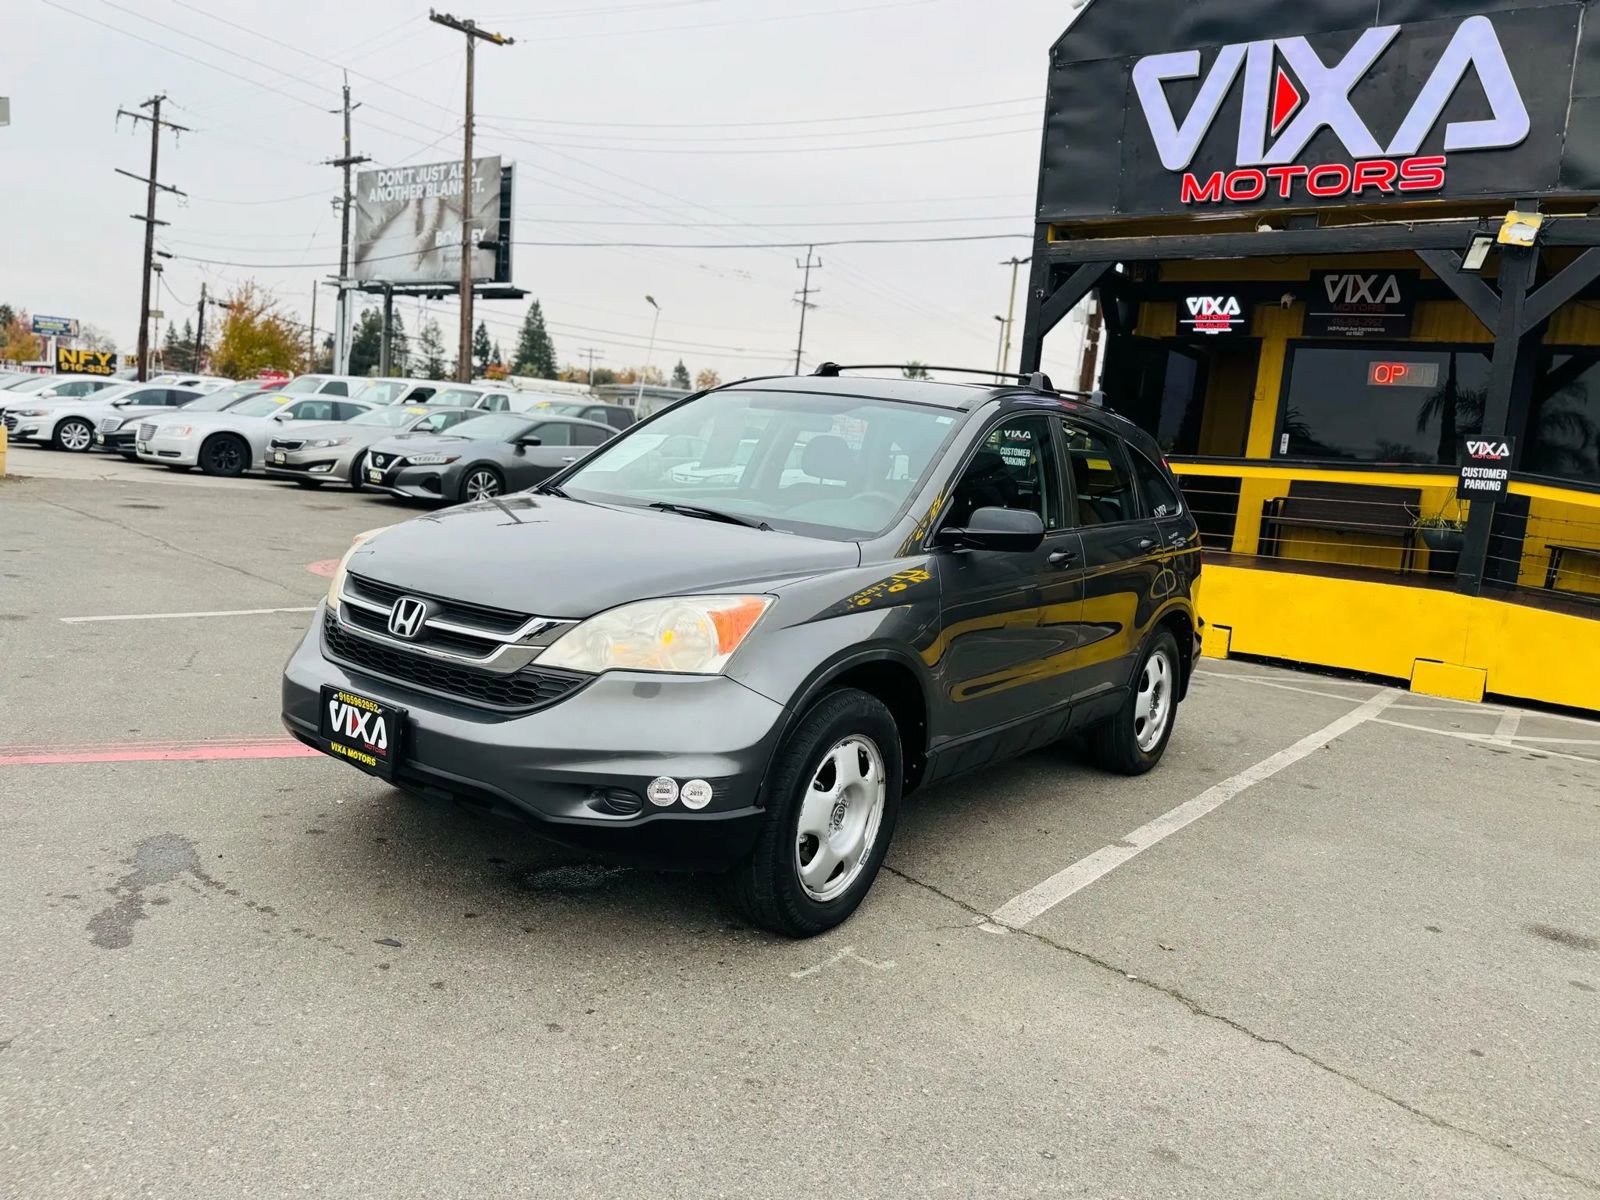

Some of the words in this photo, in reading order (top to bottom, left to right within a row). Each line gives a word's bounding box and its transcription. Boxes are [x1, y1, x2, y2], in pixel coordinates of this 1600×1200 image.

[1132, 15, 1530, 171] VIXA
[378, 170, 415, 186] DON'T
[416, 165, 448, 182] JUST
[1181, 155, 1447, 204] MOTORS
[369, 184, 424, 202] ANOTHER
[1324, 274, 1402, 304] VIXA
[1186, 296, 1241, 315] VIXA
[1333, 303, 1386, 312] MOTORS
[59, 348, 112, 366] NFY
[1000, 447, 1031, 457] CUSTOMER
[1466, 441, 1509, 456] VIXA
[1002, 456, 1026, 466] PARKING
[1462, 467, 1507, 480] CUSTOMER
[1464, 479, 1501, 491] PARKING
[338, 691, 380, 713] 9165962952
[329, 699, 388, 750] VIXA
[330, 741, 347, 755] VIXA
[347, 749, 377, 767] MOTORS
